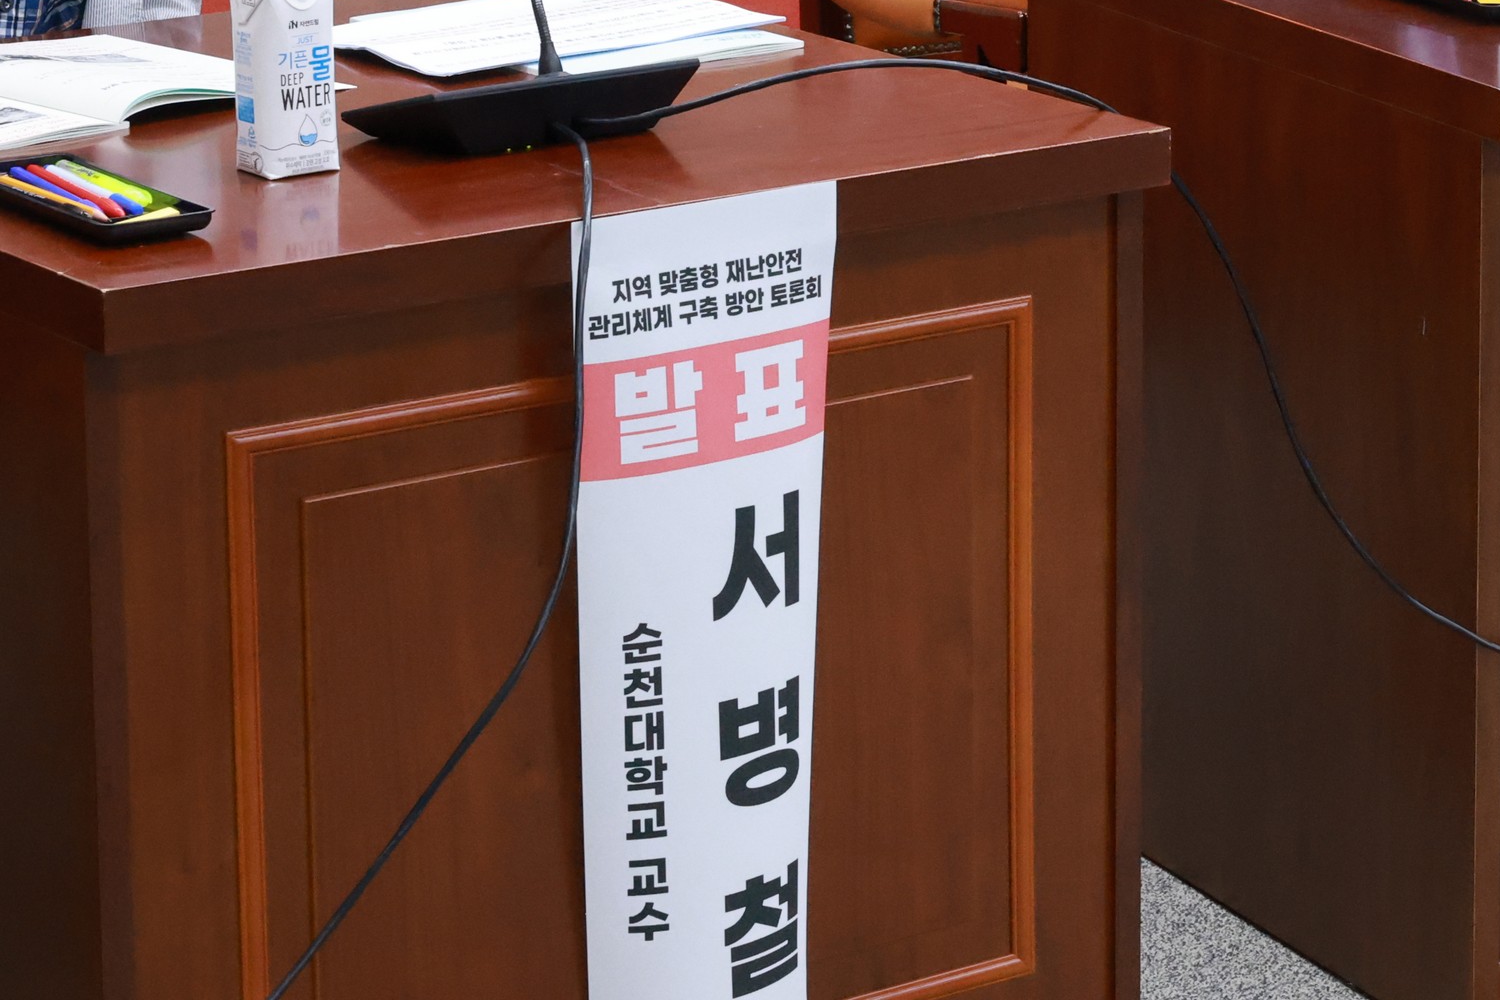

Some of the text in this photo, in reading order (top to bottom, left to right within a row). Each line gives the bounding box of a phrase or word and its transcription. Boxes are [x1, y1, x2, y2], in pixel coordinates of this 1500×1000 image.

[280, 72, 305, 87] DEEP
[281, 83, 331, 111] WATER
[611, 248, 803, 304] 지역 맞춤형 재난안전
[588, 274, 822, 341] 관리체계 구축 방안 토론회
[621, 621, 670, 942] 순천대학교 교수
